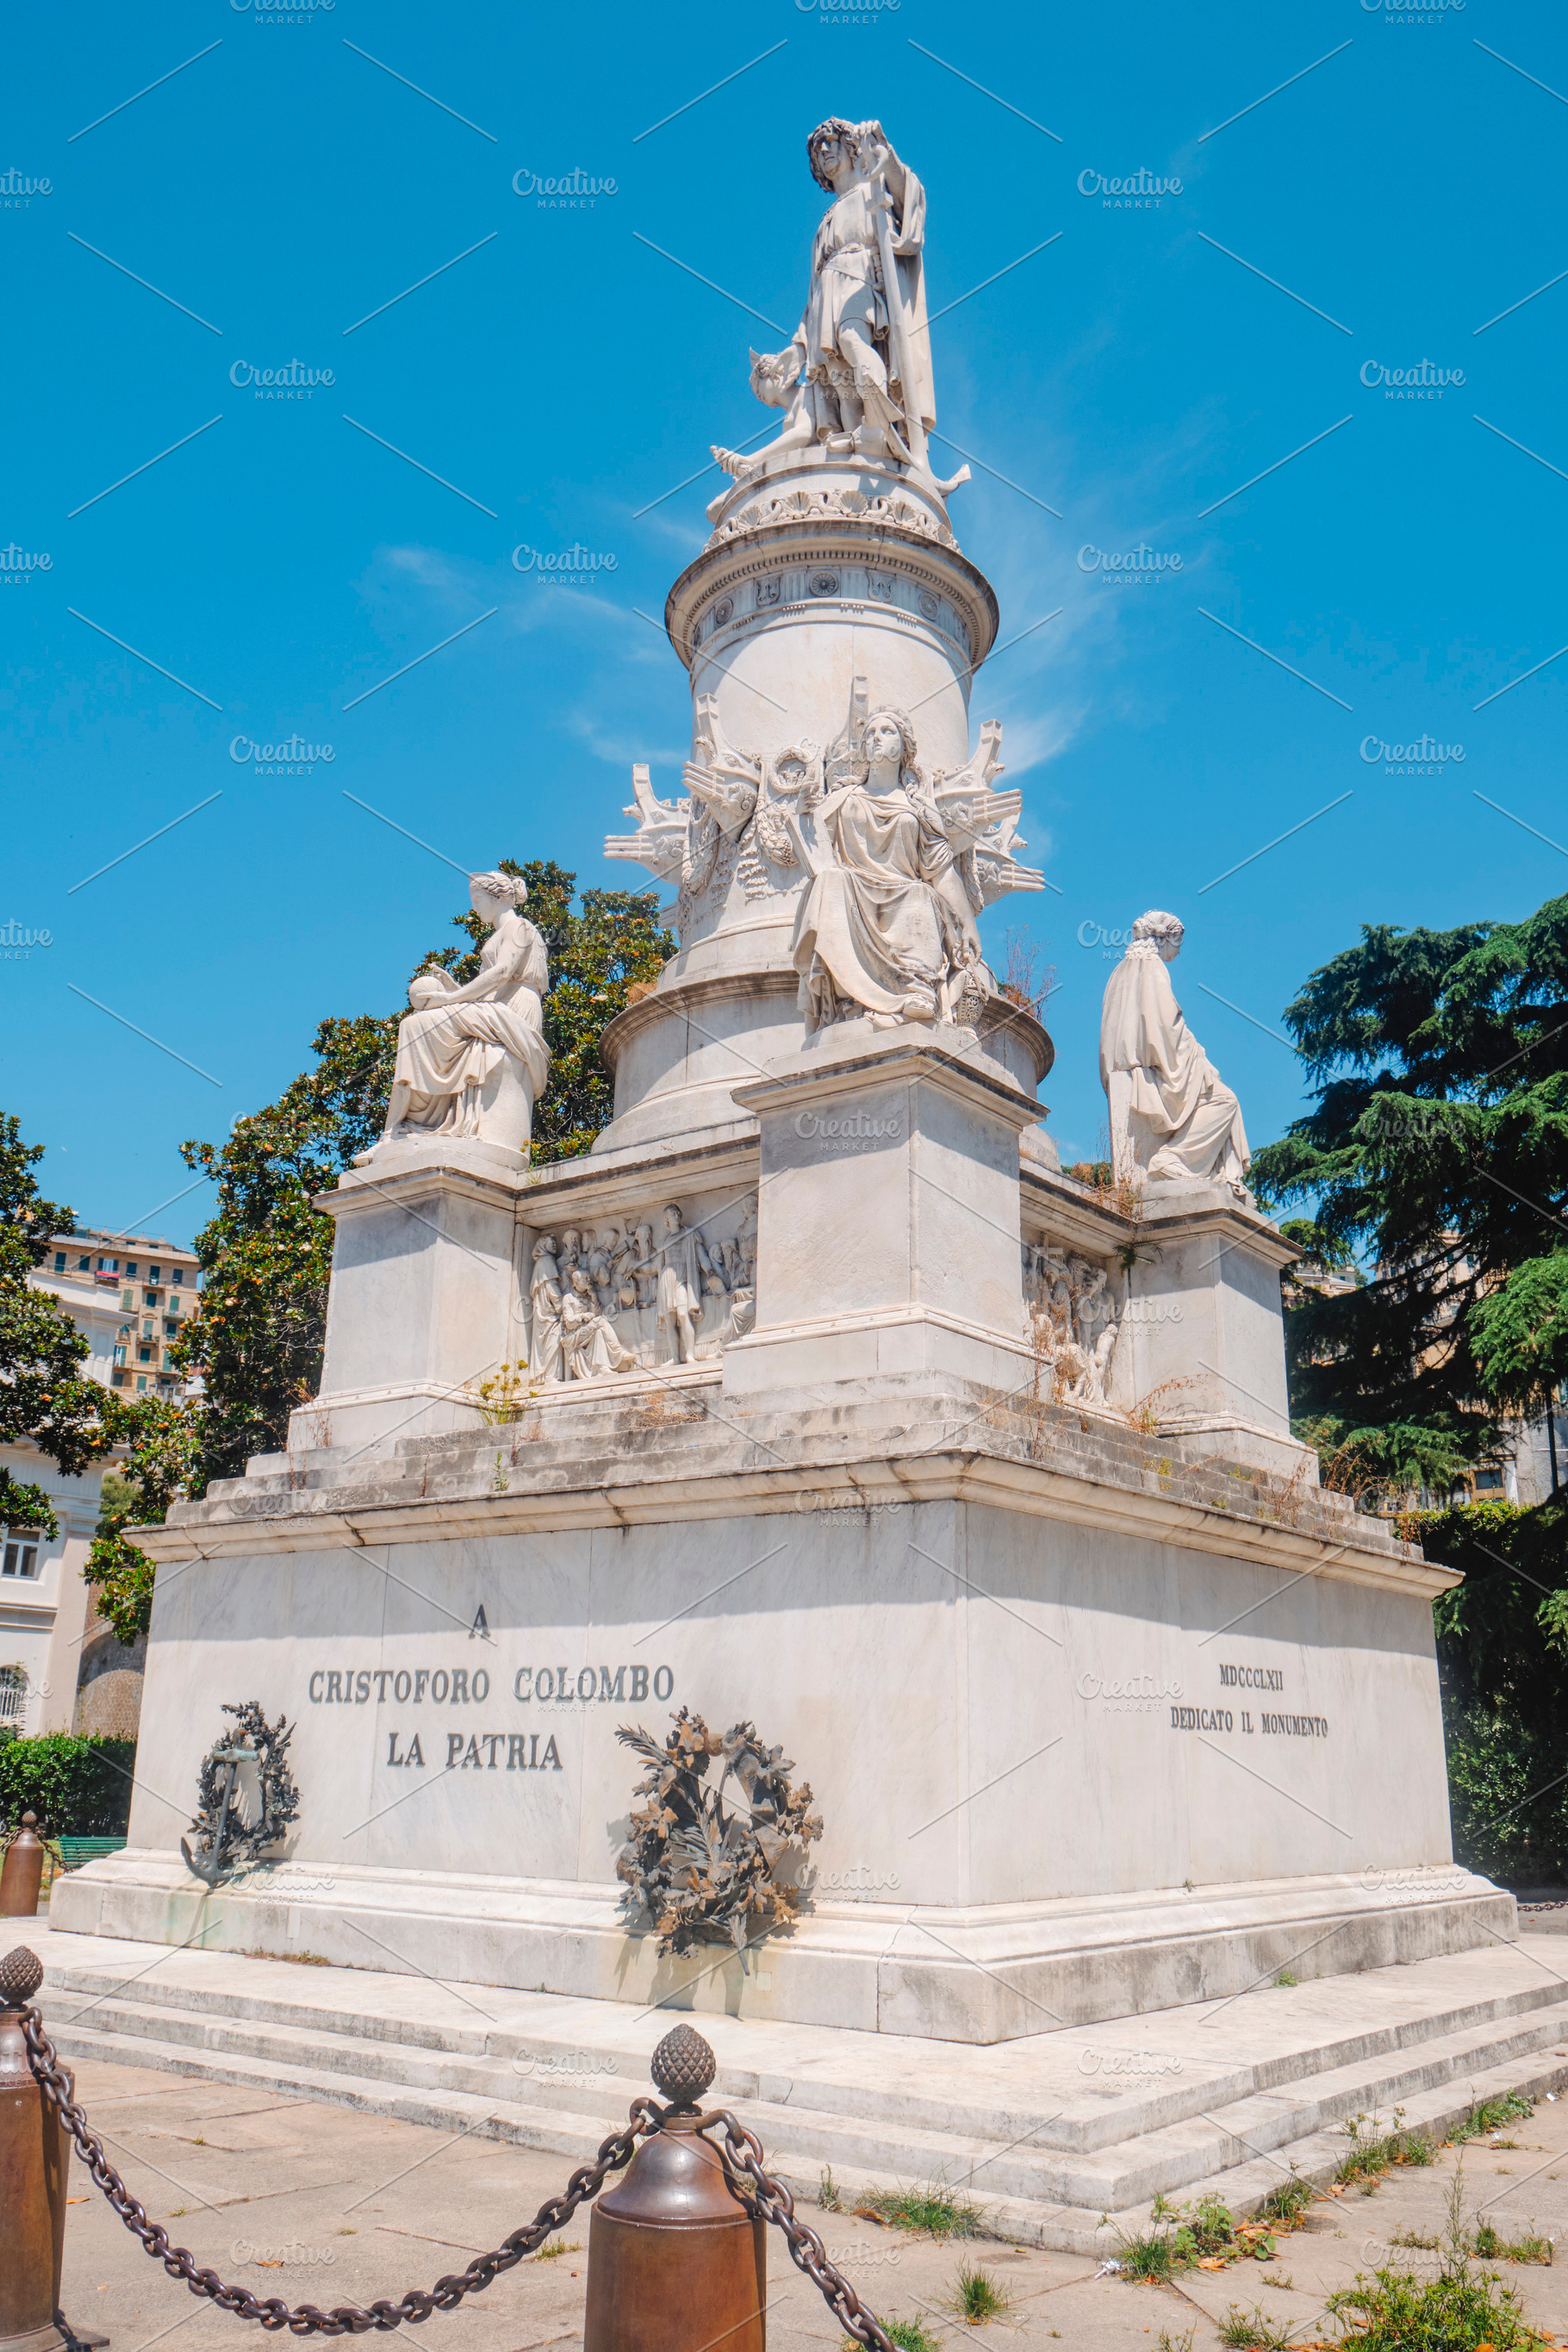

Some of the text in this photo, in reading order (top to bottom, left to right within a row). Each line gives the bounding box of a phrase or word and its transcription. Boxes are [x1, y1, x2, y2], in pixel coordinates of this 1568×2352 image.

[469, 1603, 490, 1640] A
[309, 1664, 674, 1704] CRISTOFORO COLOMBO
[1220, 1664, 1284, 1691] MDCCCLXII
[1170, 1706, 1328, 1739] DEDICATO IL MONUMENTO
[387, 1733, 563, 1771] LA PATRIA
